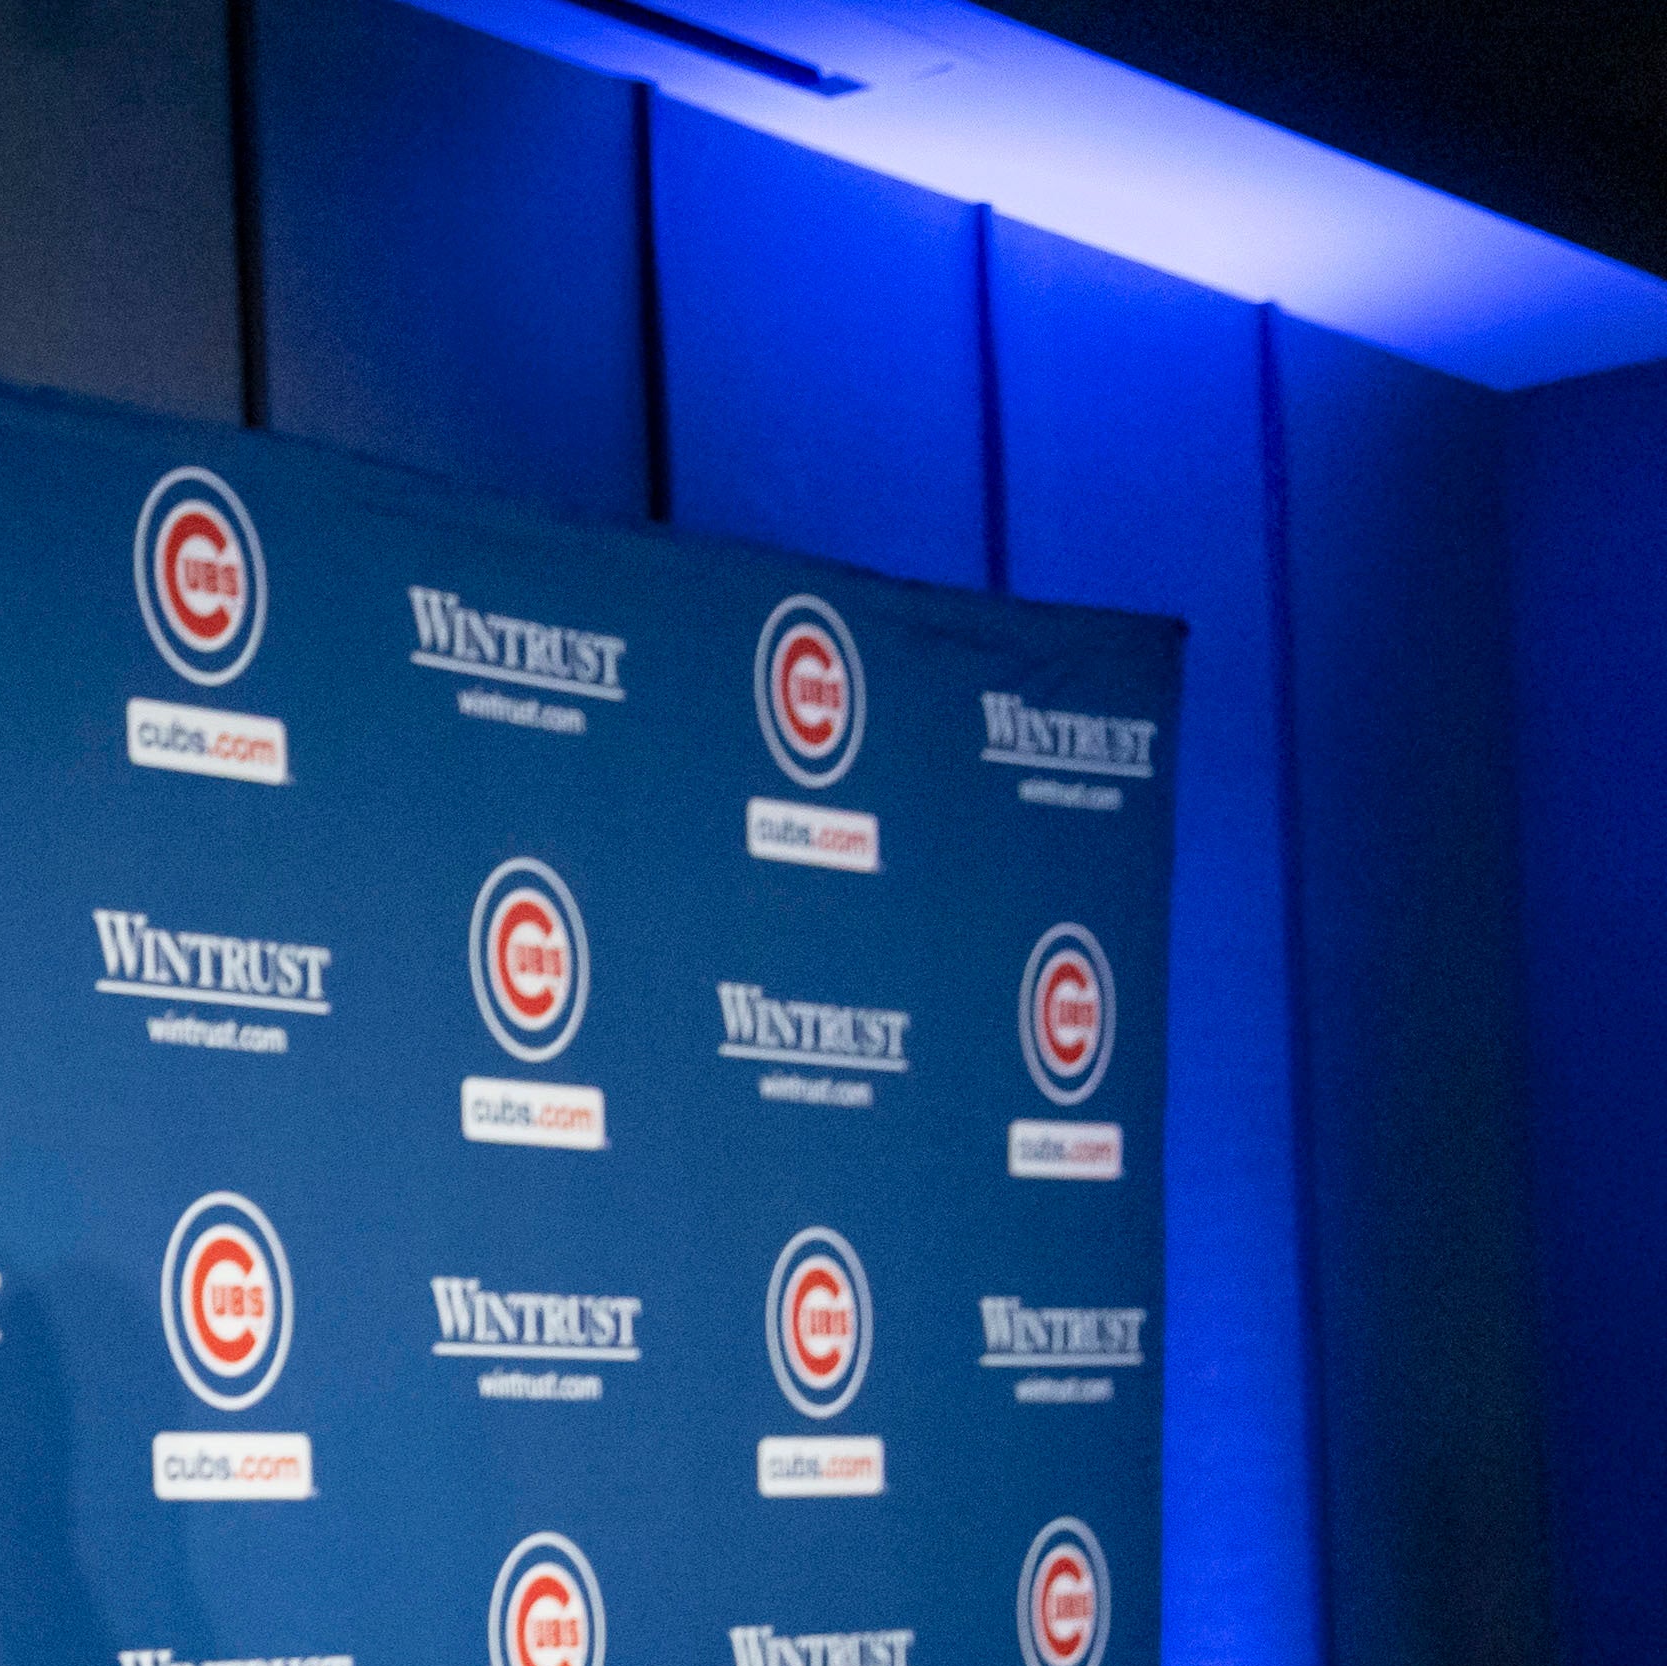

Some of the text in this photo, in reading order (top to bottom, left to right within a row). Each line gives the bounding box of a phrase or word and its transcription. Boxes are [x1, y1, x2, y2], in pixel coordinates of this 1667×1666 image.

[164, 512, 239, 640] CUBS
[409, 586, 626, 690] WINTRUST
[780, 635, 840, 745] CUBS
[138, 717, 277, 766] cubs.com
[982, 692, 1157, 768] WINTRUST
[756, 814, 869, 853] cubs.com
[94, 909, 330, 998] WINTRUST
[497, 900, 562, 1018] CUBS
[147, 1013, 287, 1053] wintrust.com
[718, 982, 910, 1059] WINTRUST
[472, 1096, 595, 1131] cubs.com
[192, 1238, 264, 1364] CUBS
[431, 1277, 640, 1347] WINTRUST
[793, 1267, 850, 1377] CUBS
[981, 1297, 1146, 1355] WINTRUST
[164, 1450, 301, 1482] cubs.com
